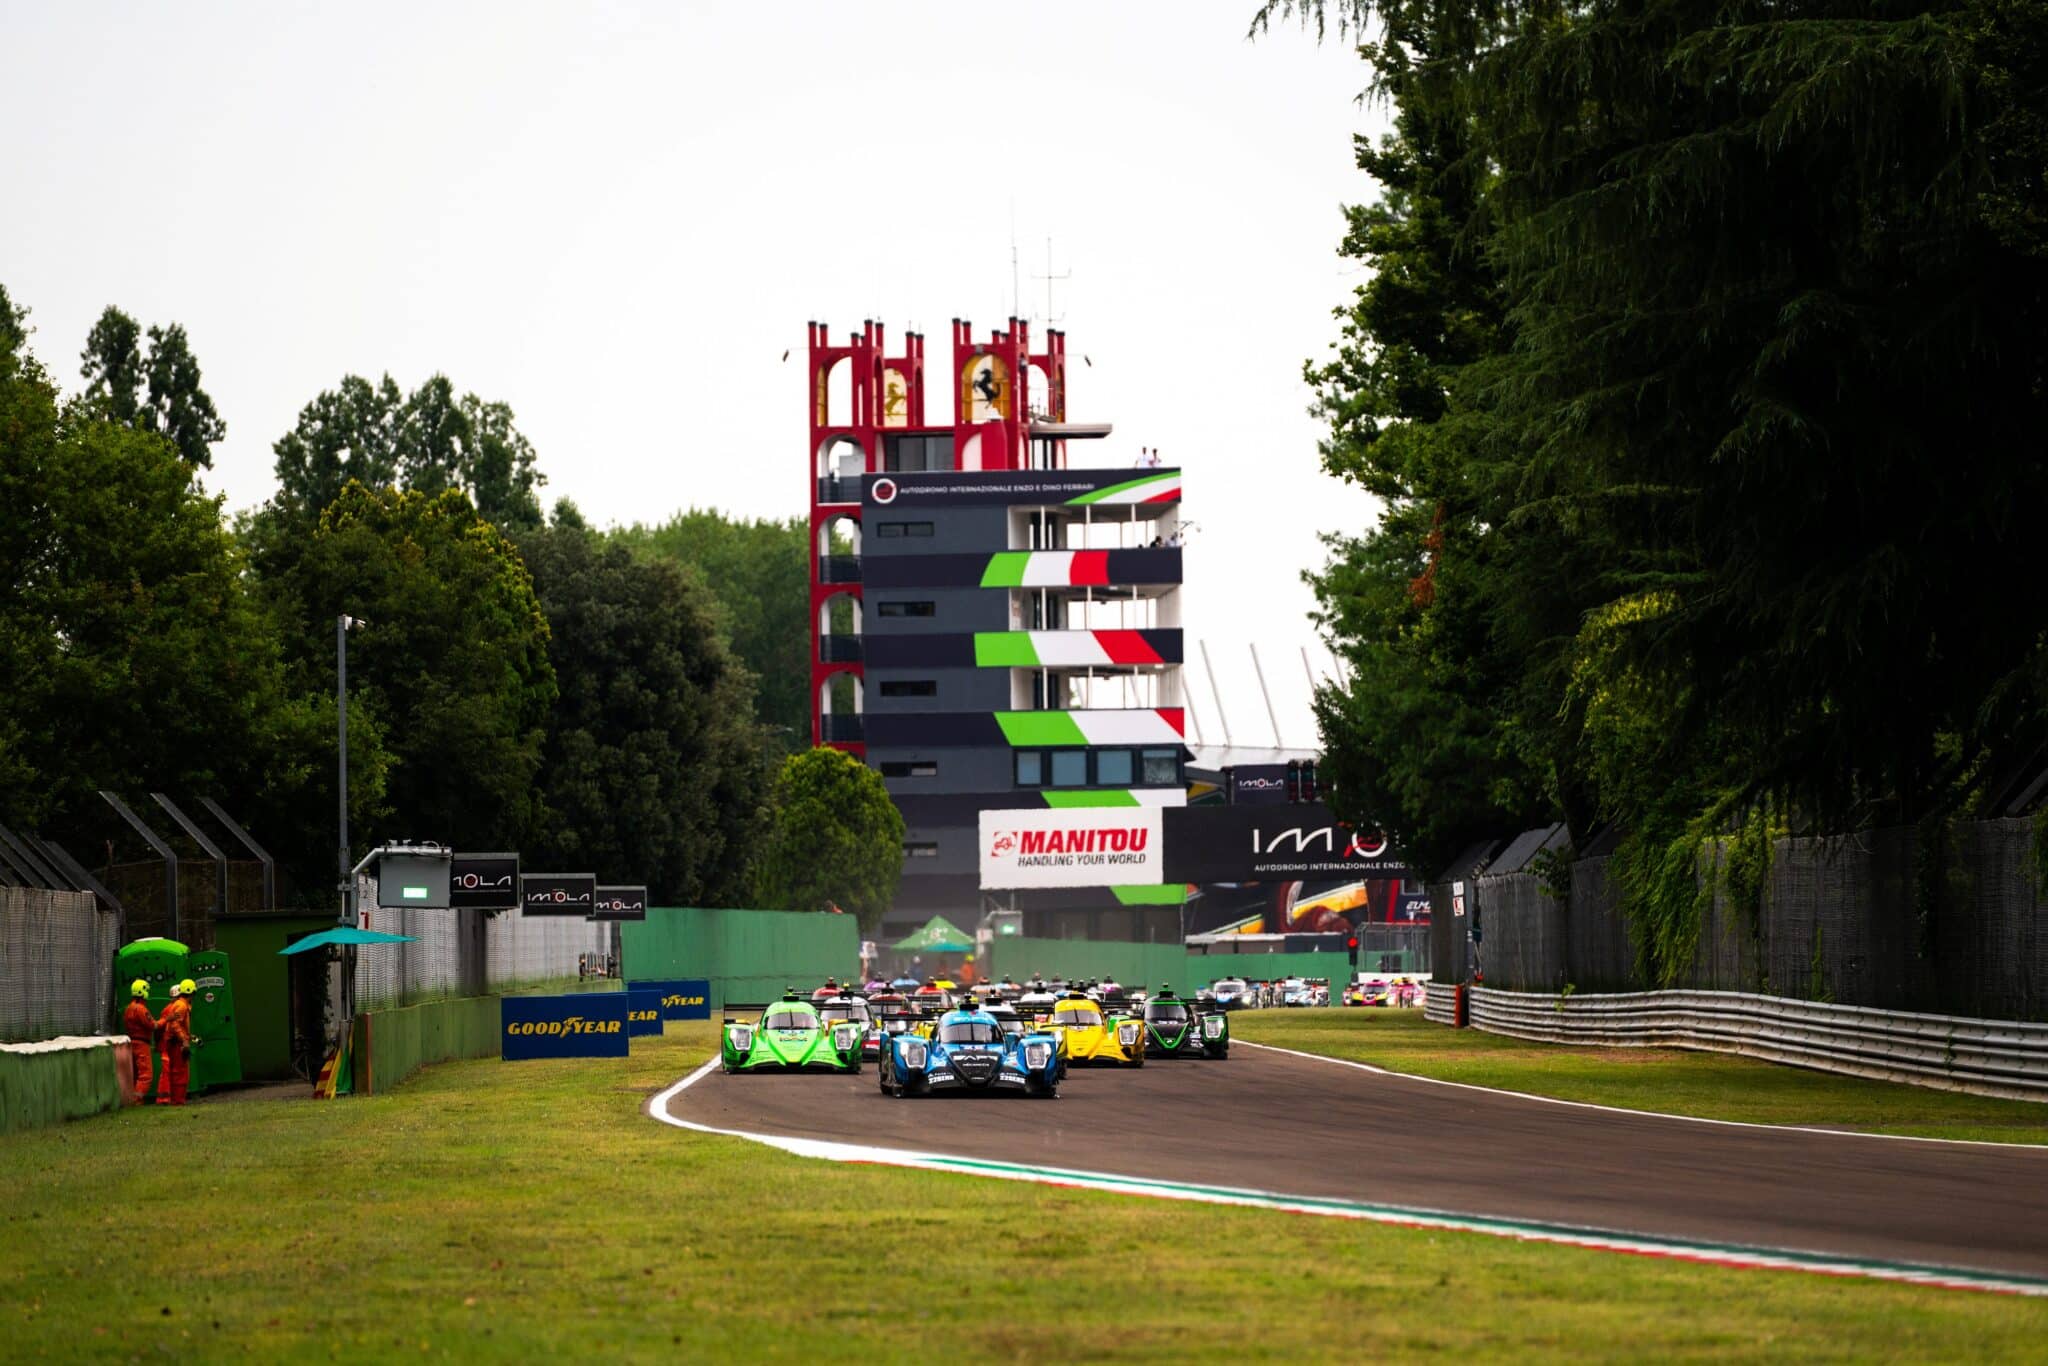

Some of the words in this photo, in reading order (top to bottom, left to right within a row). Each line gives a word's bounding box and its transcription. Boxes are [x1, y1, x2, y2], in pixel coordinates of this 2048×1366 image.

[900, 485, 947, 494] AUTODROMO
[1013, 484, 1034, 492] ENZO
[1239, 778, 1283, 788] IMOLA
[1020, 828, 1148, 854] MANITOU
[1018, 855, 1074, 867] HANDLING
[1077, 854, 1105, 866] YOUR
[1108, 853, 1146, 865] WORLD
[1254, 864, 1308, 872] AUTODROMO
[1310, 862, 1380, 871] INTERNAZIONALE
[528, 891, 590, 903] IMOLA
[507, 1016, 621, 1038] GOODYEAR
